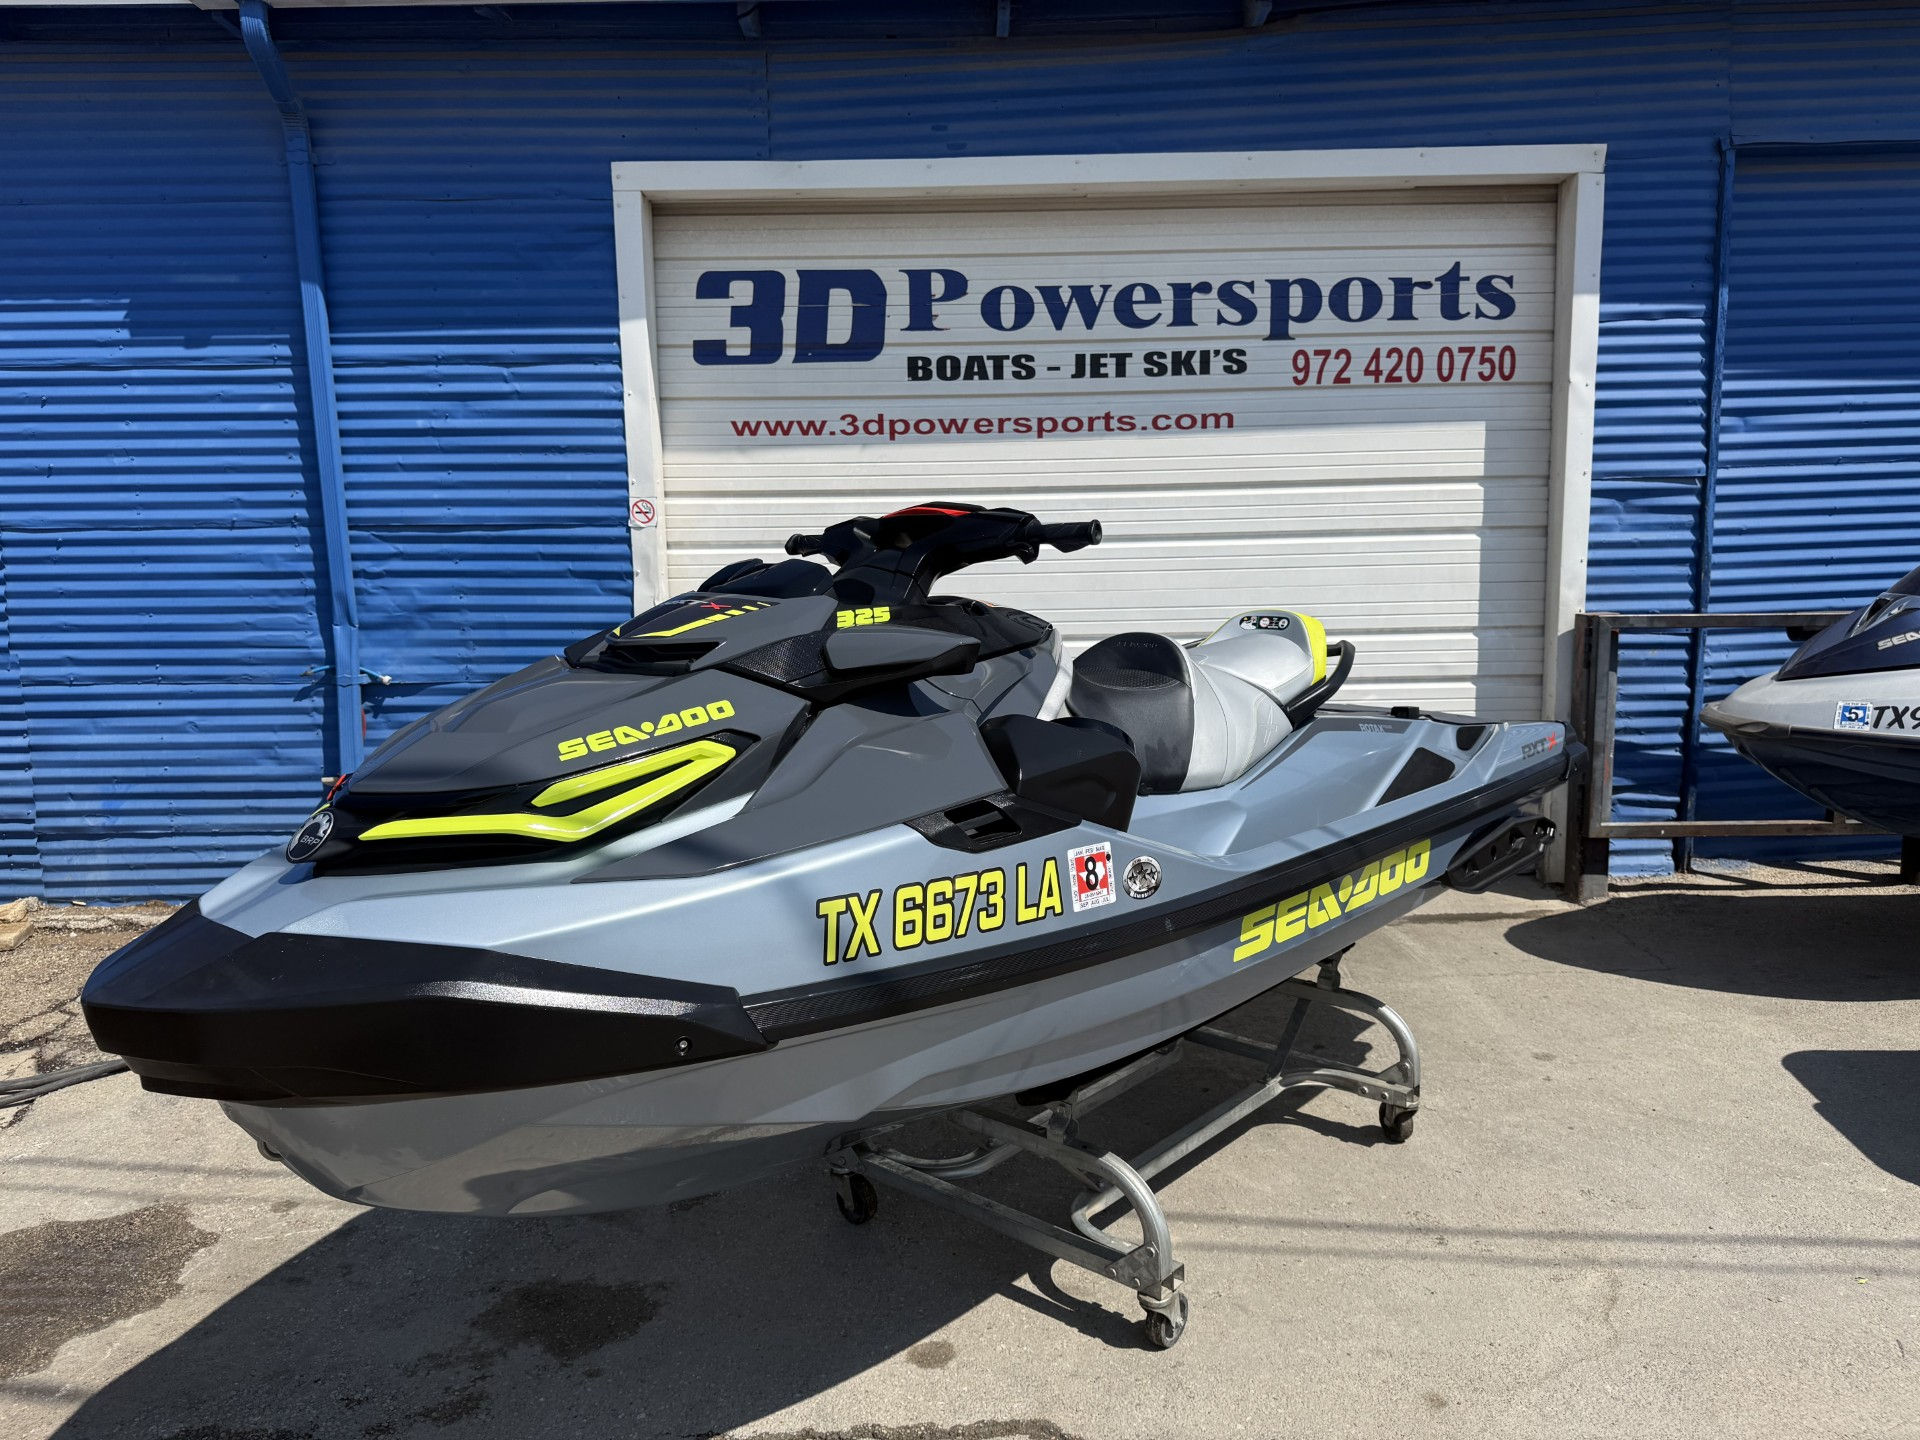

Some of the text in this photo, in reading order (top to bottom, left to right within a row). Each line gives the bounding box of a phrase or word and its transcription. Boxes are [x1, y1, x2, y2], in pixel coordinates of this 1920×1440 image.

[692, 261, 1517, 366] 3D Powersports
[907, 354, 1037, 382] BOATS
[1071, 352, 1133, 379] JET
[1143, 348, 1248, 378] SKI'S
[1292, 344, 1517, 386] 972 420 0750
[731, 411, 1235, 441] www.3dpowersports.com
[837, 606, 890, 628] 325
[1877, 631, 1920, 651] SEA
[1848, 707, 1859, 722] 5
[300, 835, 320, 845] BRP
[1085, 856, 1099, 891] 8
[816, 888, 883, 966] TX
[893, 867, 1006, 951] 6673
[1016, 857, 1063, 925] LA
